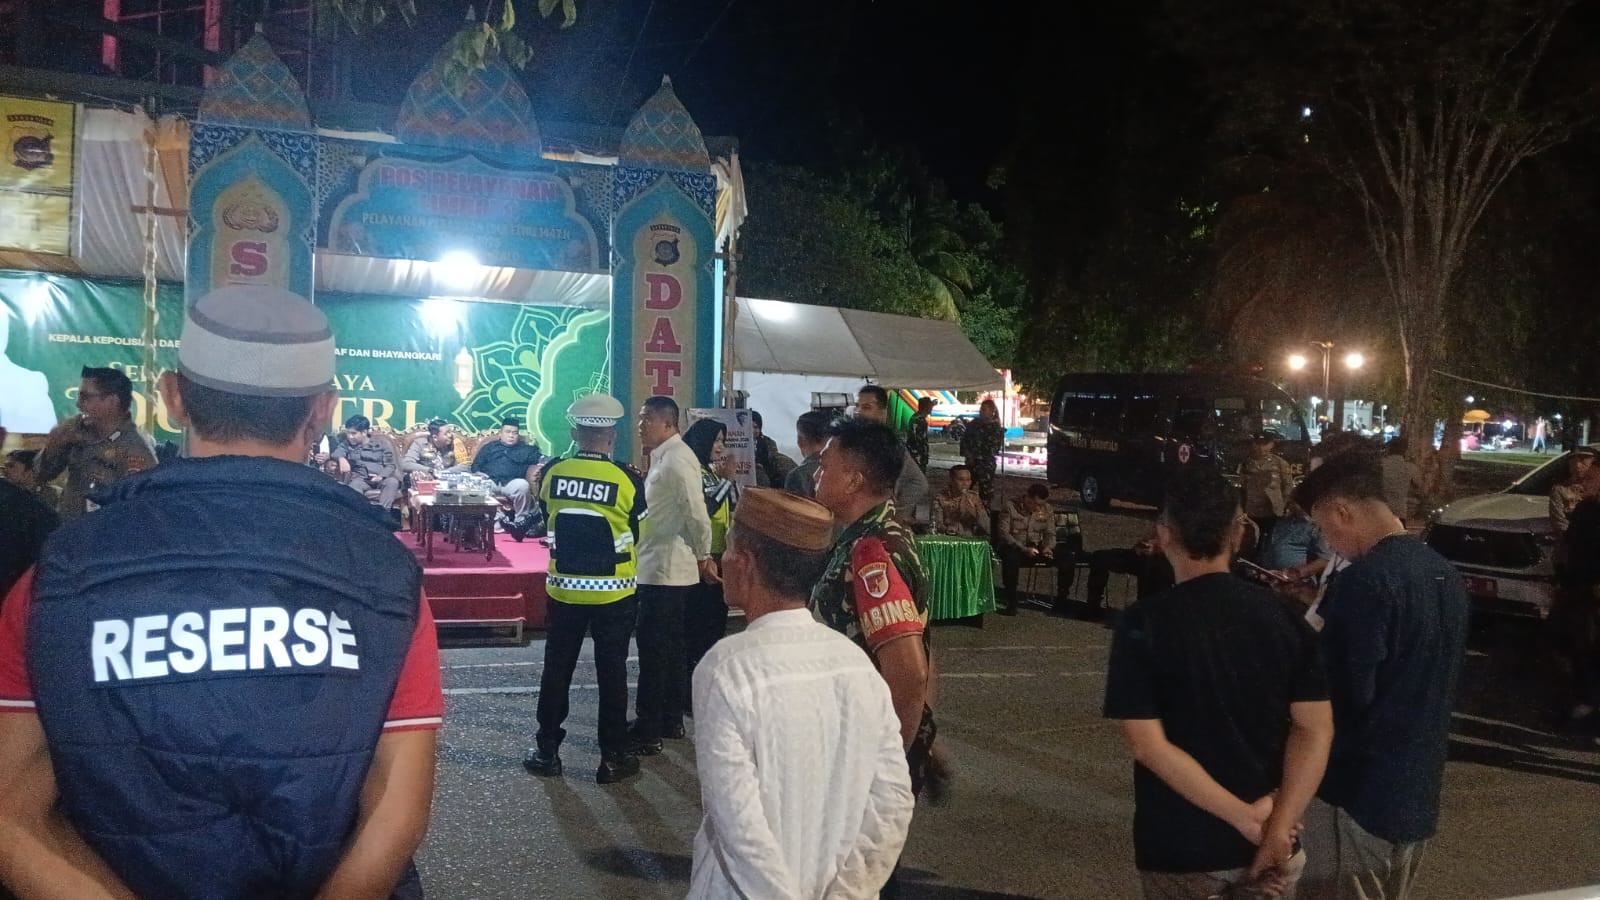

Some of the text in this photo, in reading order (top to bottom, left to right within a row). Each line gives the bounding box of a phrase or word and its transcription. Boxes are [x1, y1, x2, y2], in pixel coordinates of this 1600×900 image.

[379, 165, 426, 190] POS
[48, 334, 92, 345] KEPALA
[349, 350, 370, 358] DAN
[372, 350, 442, 361] BHAYANGKARI
[556, 478, 610, 502] POLISI
[91, 606, 360, 682] RESERSE
